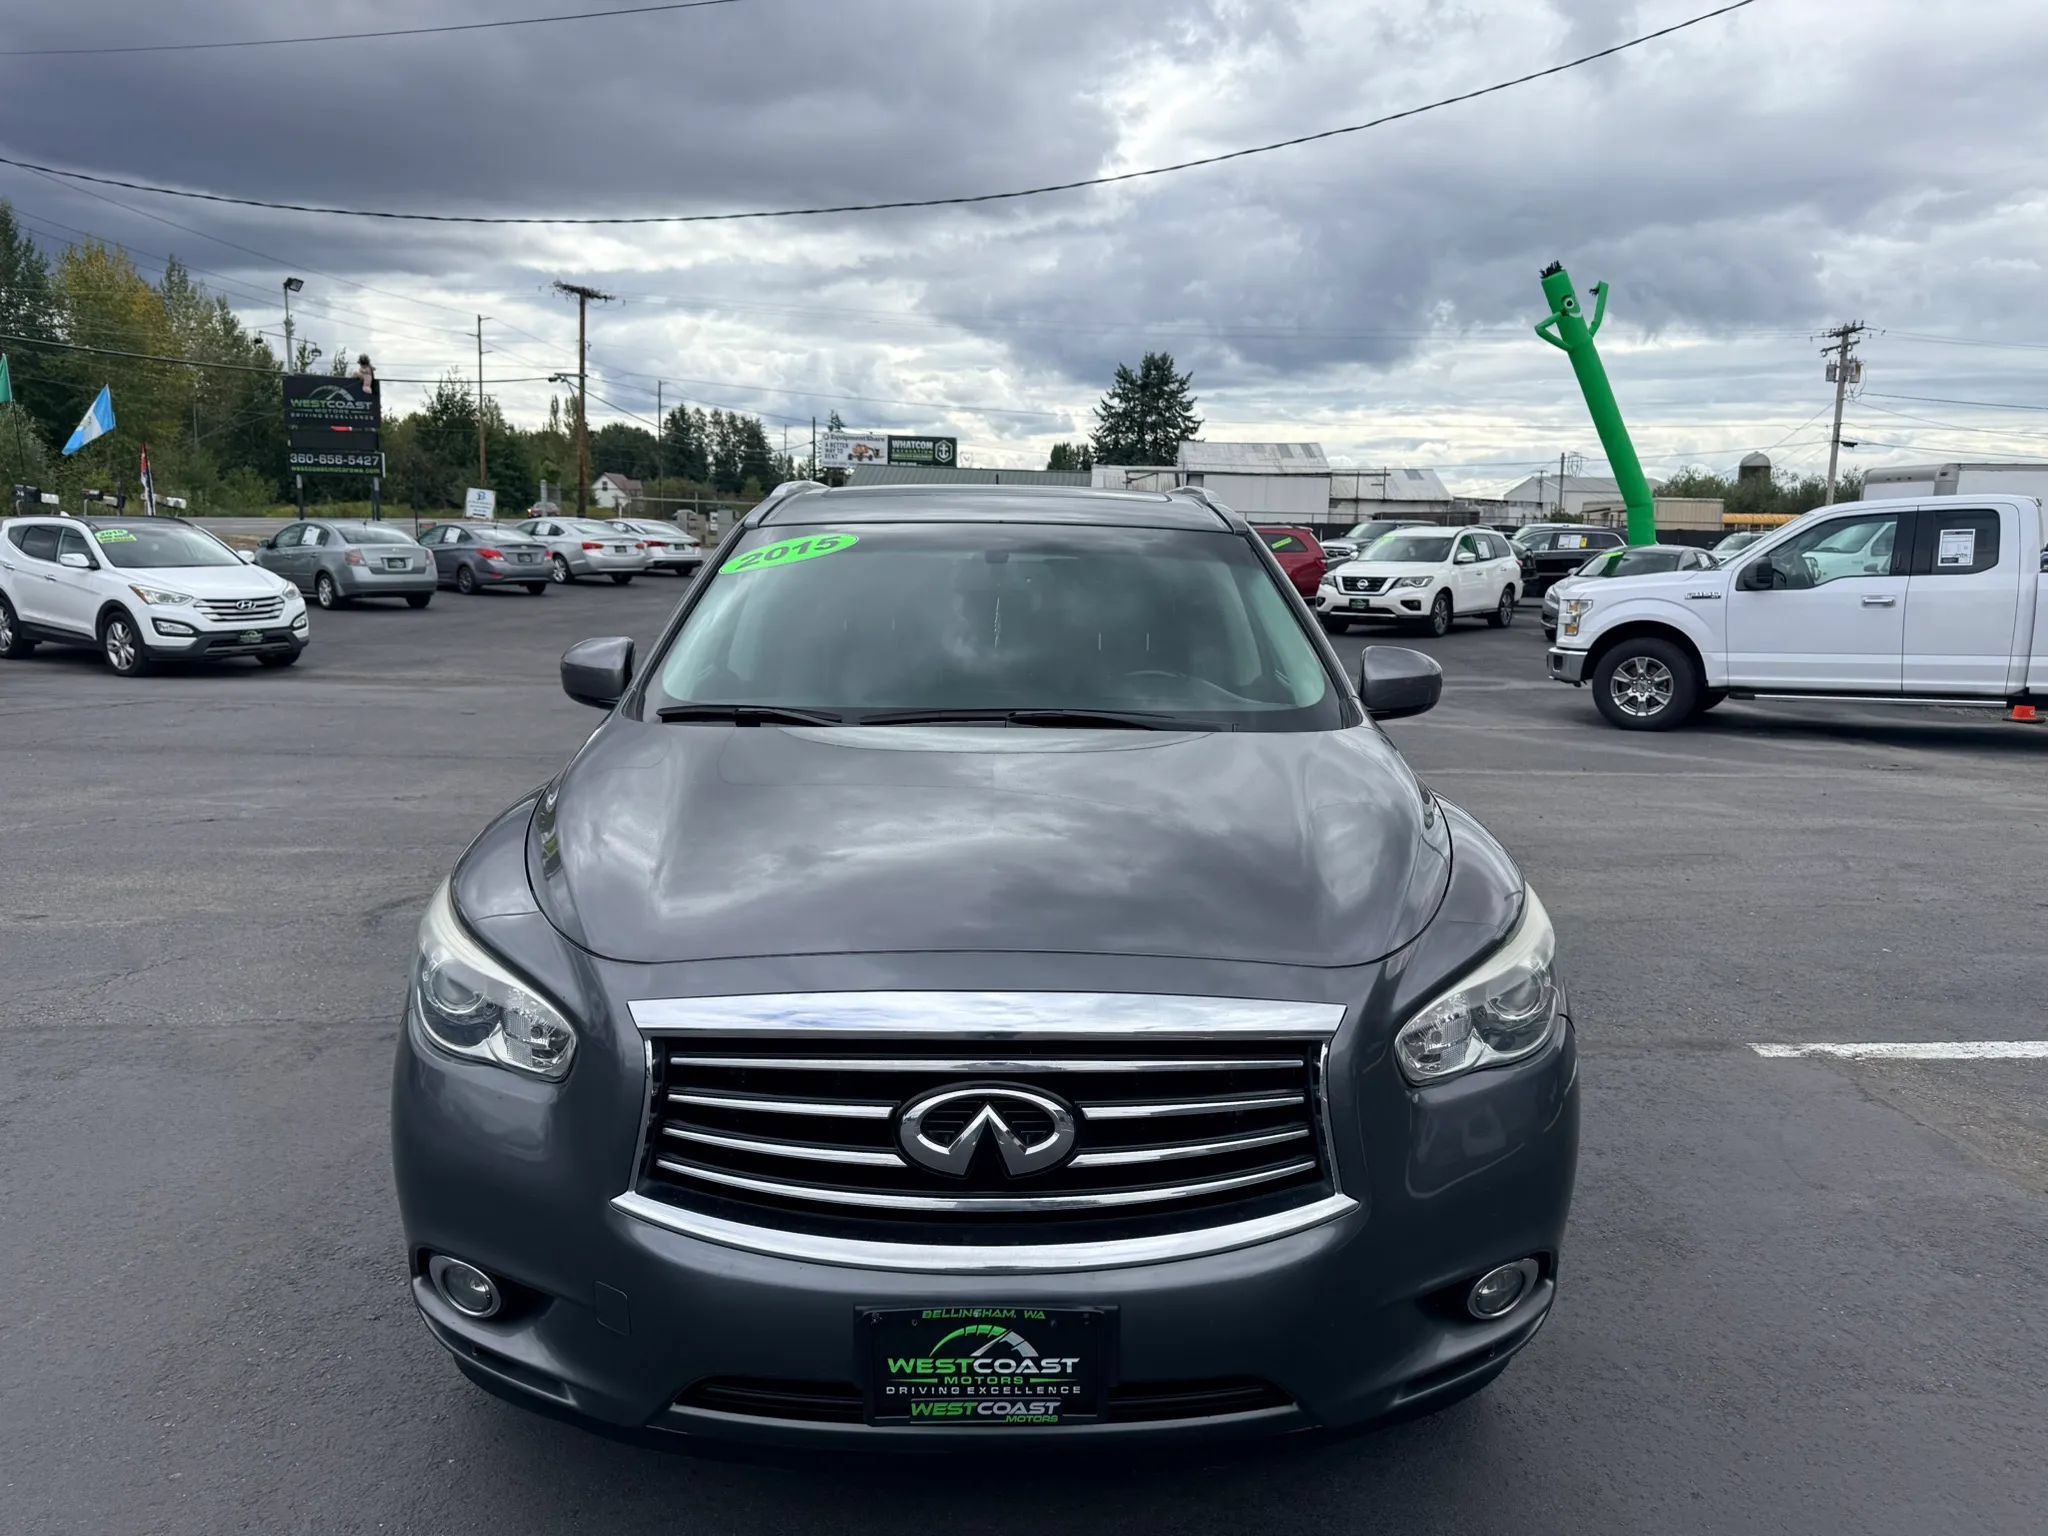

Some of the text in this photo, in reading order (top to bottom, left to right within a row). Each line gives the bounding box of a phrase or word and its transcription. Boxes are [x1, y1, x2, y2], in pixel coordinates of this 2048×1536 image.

[290, 399, 372, 409] WESTCOAST
[892, 440, 933, 450] WHATCOM
[735, 536, 841, 570] 2015
[1023, 1310, 1047, 1319] WA
[887, 1358, 1080, 1374] WESTCOAST
[944, 1376, 1024, 1385] MOTORS
[886, 1386, 1081, 1394] DRIVING EXCELLENCE
[911, 1402, 1061, 1416] WESTCOAST
